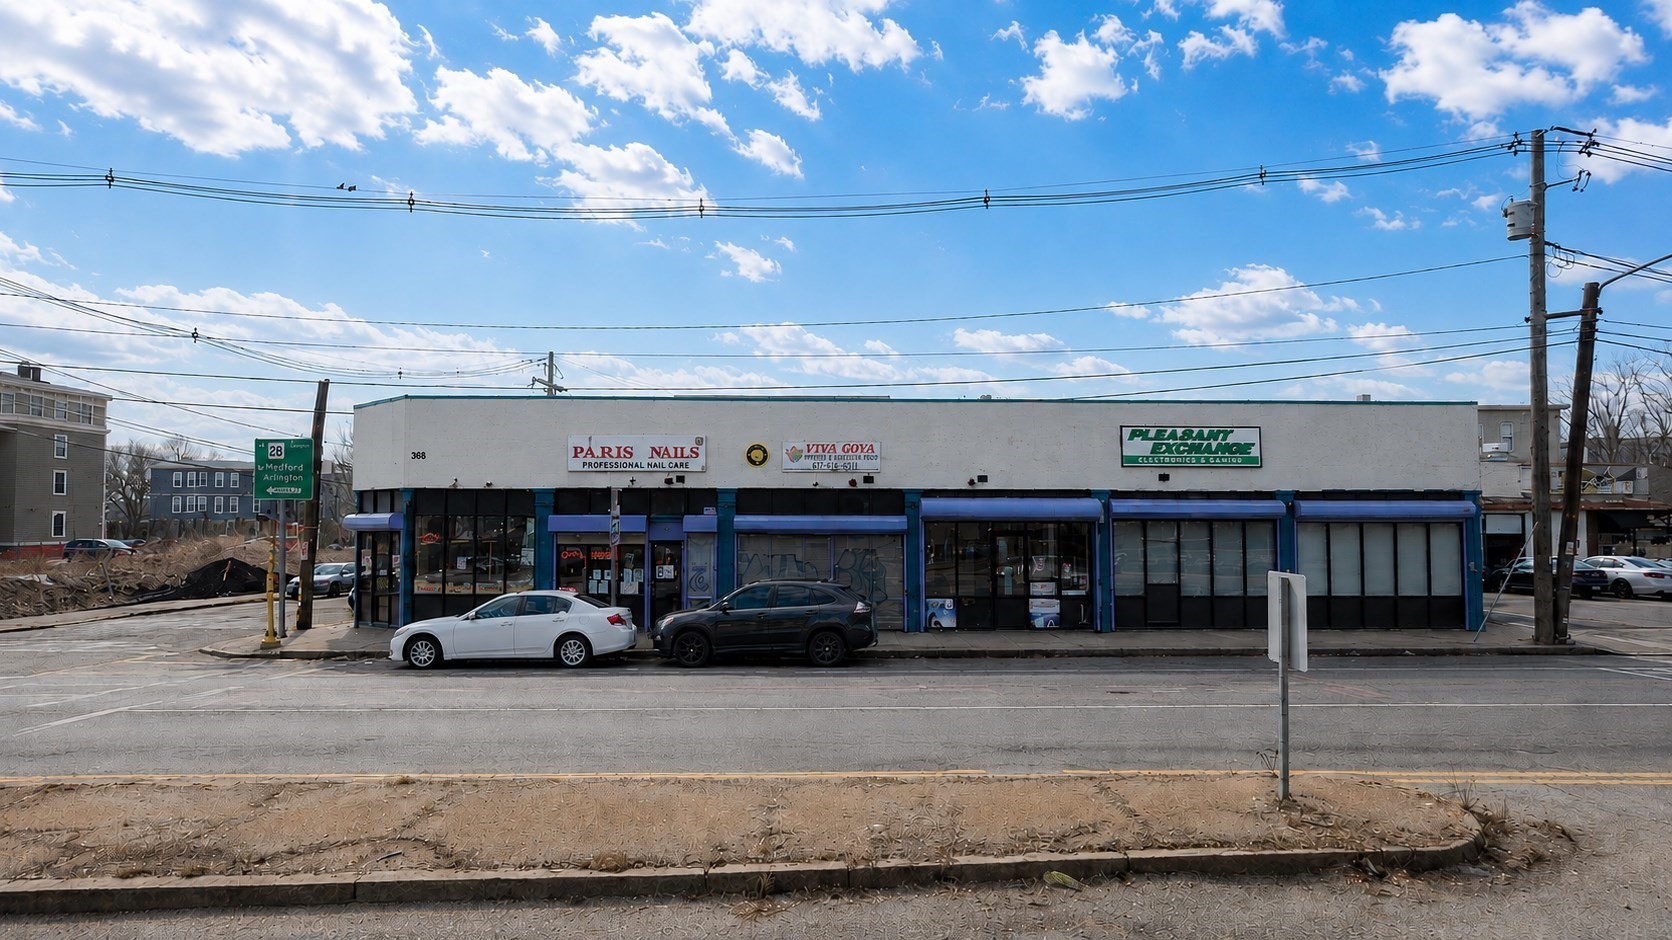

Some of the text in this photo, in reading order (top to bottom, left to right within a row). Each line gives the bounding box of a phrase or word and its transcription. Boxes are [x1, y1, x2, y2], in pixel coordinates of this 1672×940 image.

[1127, 429, 1234, 441] PLEASANT
[270, 446, 282, 456] 28
[572, 446, 700, 459] PARIS NAILS
[806, 443, 875, 454] VIVA GOYA
[1150, 442, 1256, 455] EXCHANGE
[263, 474, 304, 482] Arlington
